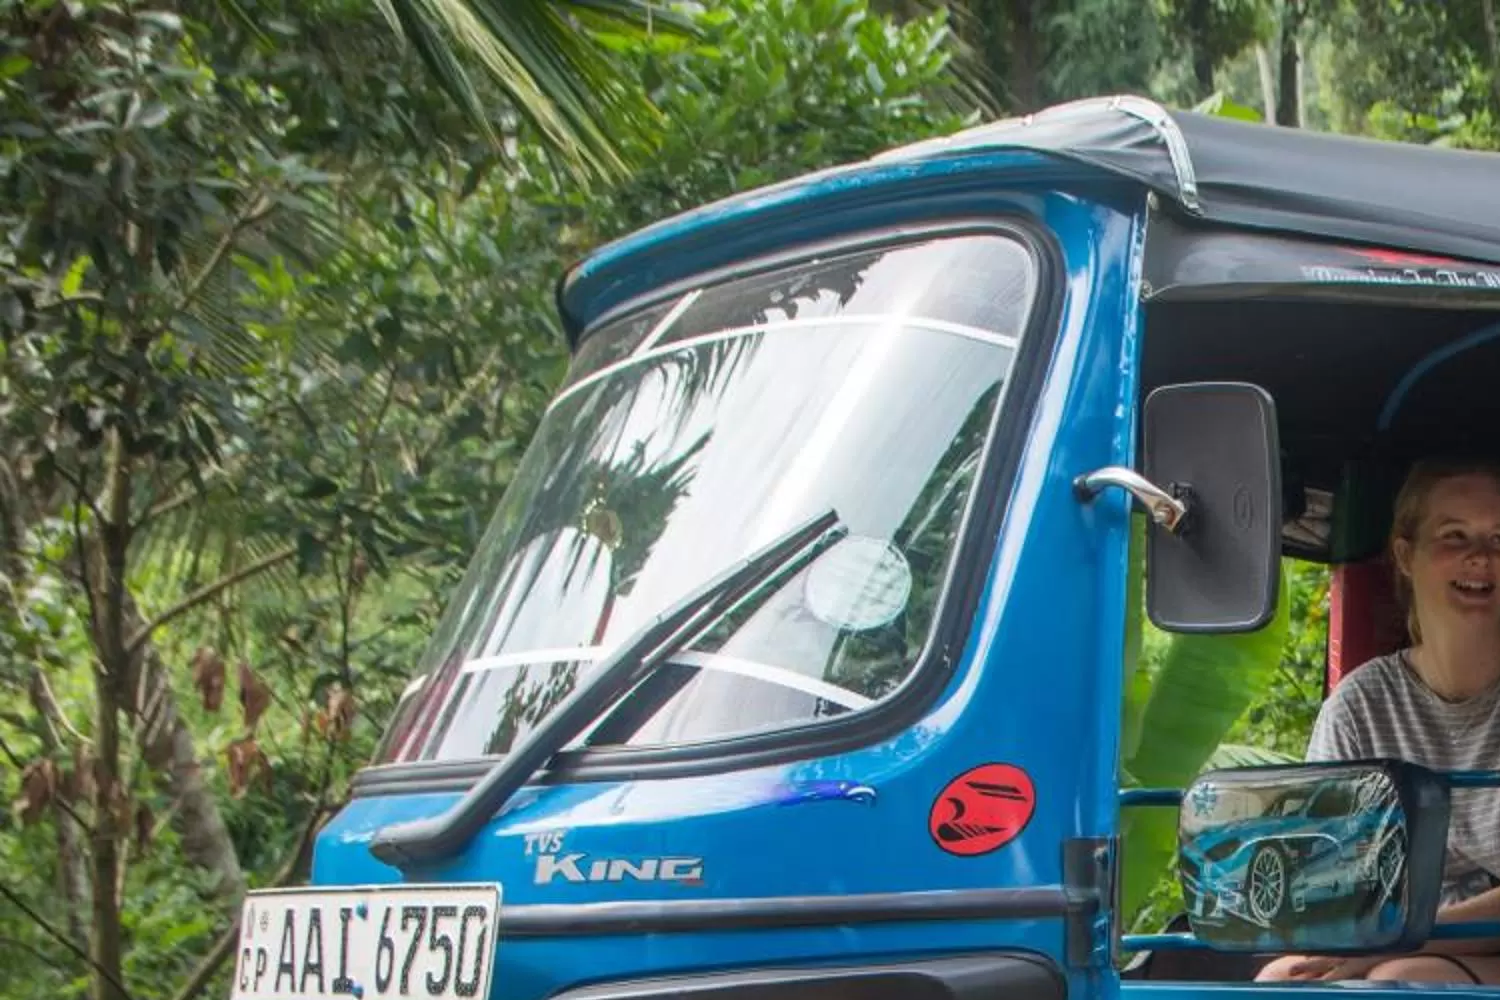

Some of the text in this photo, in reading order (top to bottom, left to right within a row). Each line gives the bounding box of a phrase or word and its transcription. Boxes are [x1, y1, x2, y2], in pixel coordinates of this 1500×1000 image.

[524, 828, 567, 856] TVS
[533, 852, 704, 885] KING
[239, 947, 268, 993] CP
[375, 905, 488, 998] 6750
